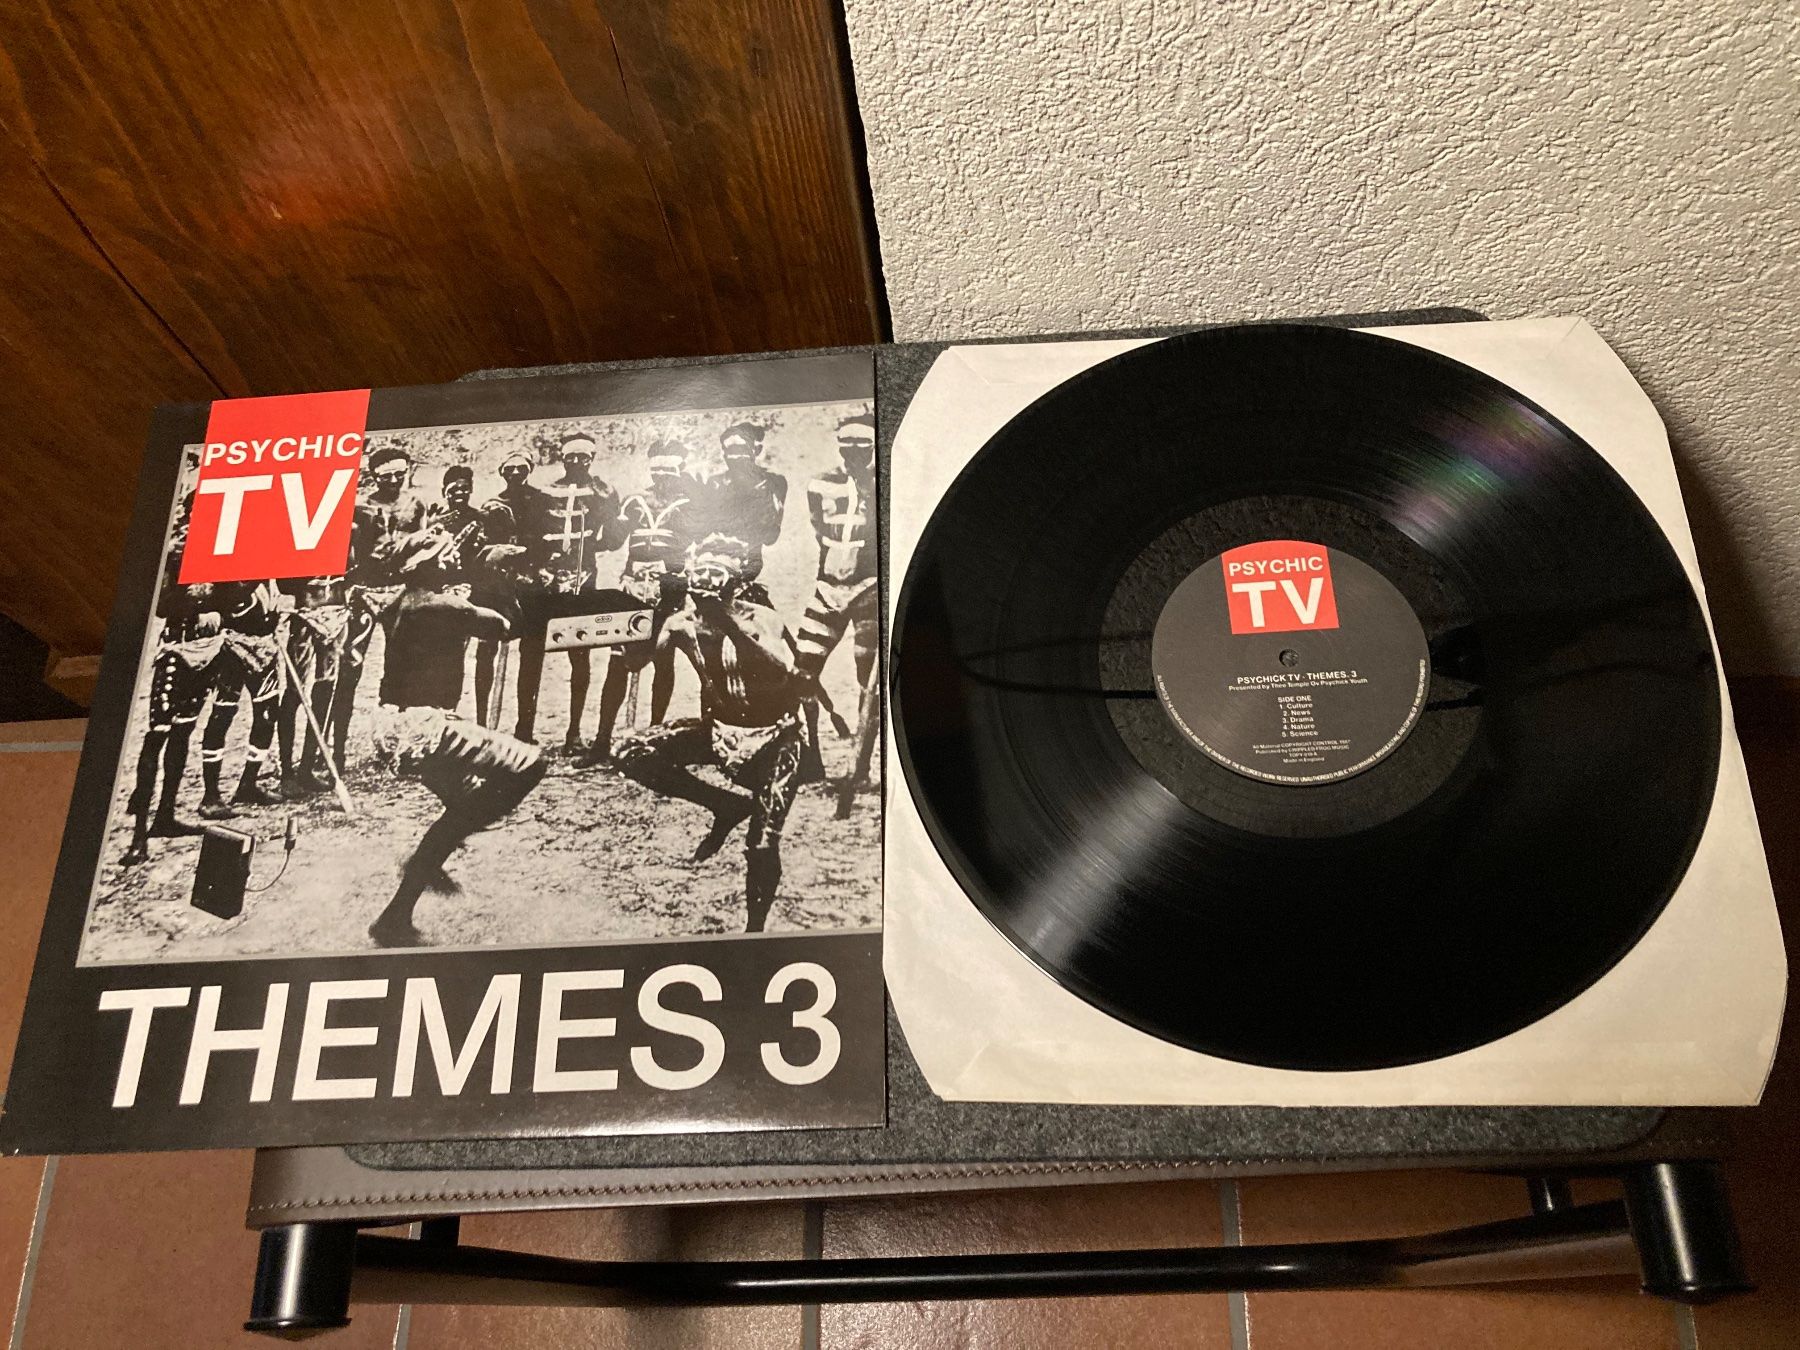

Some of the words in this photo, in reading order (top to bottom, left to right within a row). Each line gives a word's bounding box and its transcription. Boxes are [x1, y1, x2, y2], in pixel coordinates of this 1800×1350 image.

[203, 432, 361, 466] PSYCHIC
[199, 468, 354, 555] TV
[1228, 557, 1323, 576] PSYCHIC
[1232, 577, 1324, 628] TV
[1237, 674, 1286, 684] PSYCHICK
[98, 964, 725, 1108] THEMES
[760, 962, 841, 1085] 3
